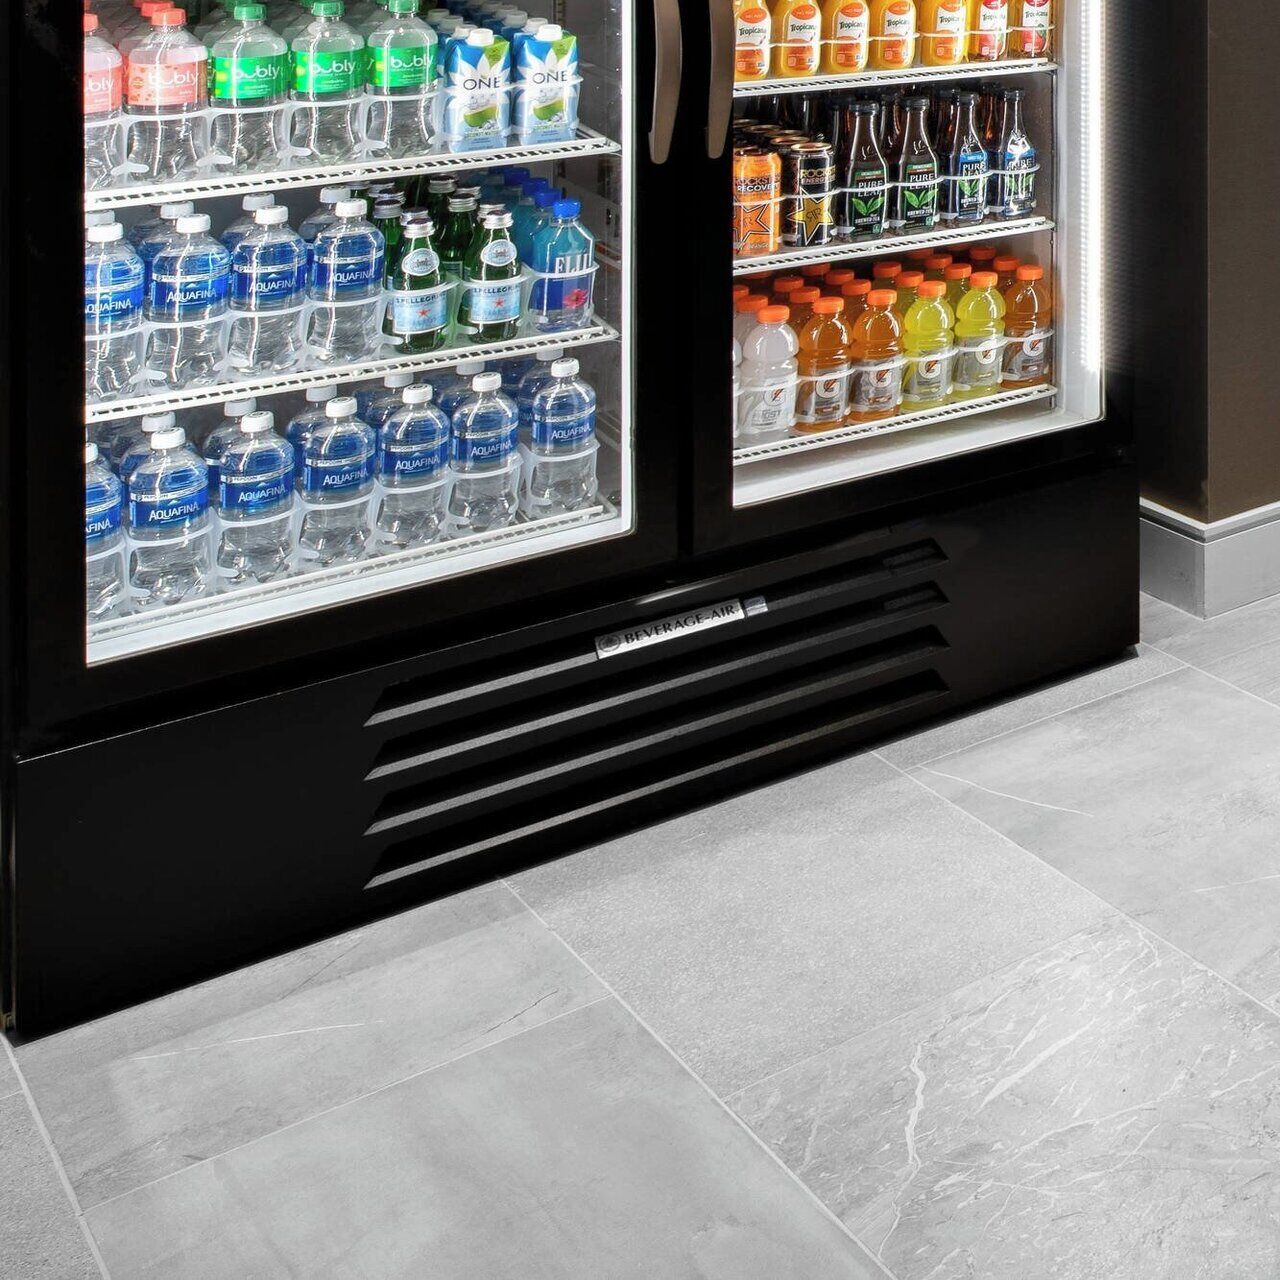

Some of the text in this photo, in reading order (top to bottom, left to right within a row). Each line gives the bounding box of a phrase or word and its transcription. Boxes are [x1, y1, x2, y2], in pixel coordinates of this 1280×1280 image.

[389, 53, 435, 70] bubly
[462, 75, 501, 91] ONE
[532, 70, 569, 84] ONE
[963, 162, 985, 172] PURE
[858, 180, 884, 189] PURE
[910, 173, 935, 183] PURE
[331, 269, 376, 284] AQUAFINA
[249, 278, 297, 294] AQUAFINA
[166, 287, 218, 304] AQUAFINA
[85, 297, 133, 315] QUAFINA
[551, 425, 592, 441] AQUAFINA
[472, 440, 513, 457] AQUAFINA
[395, 454, 440, 471] AQUAFINA
[323, 467, 369, 487] AQUAFINA
[238, 483, 287, 504] AQUAFINA
[149, 502, 200, 522] AQUAFINA
[624, 604, 735, 644] BEVERAGE-AIR
